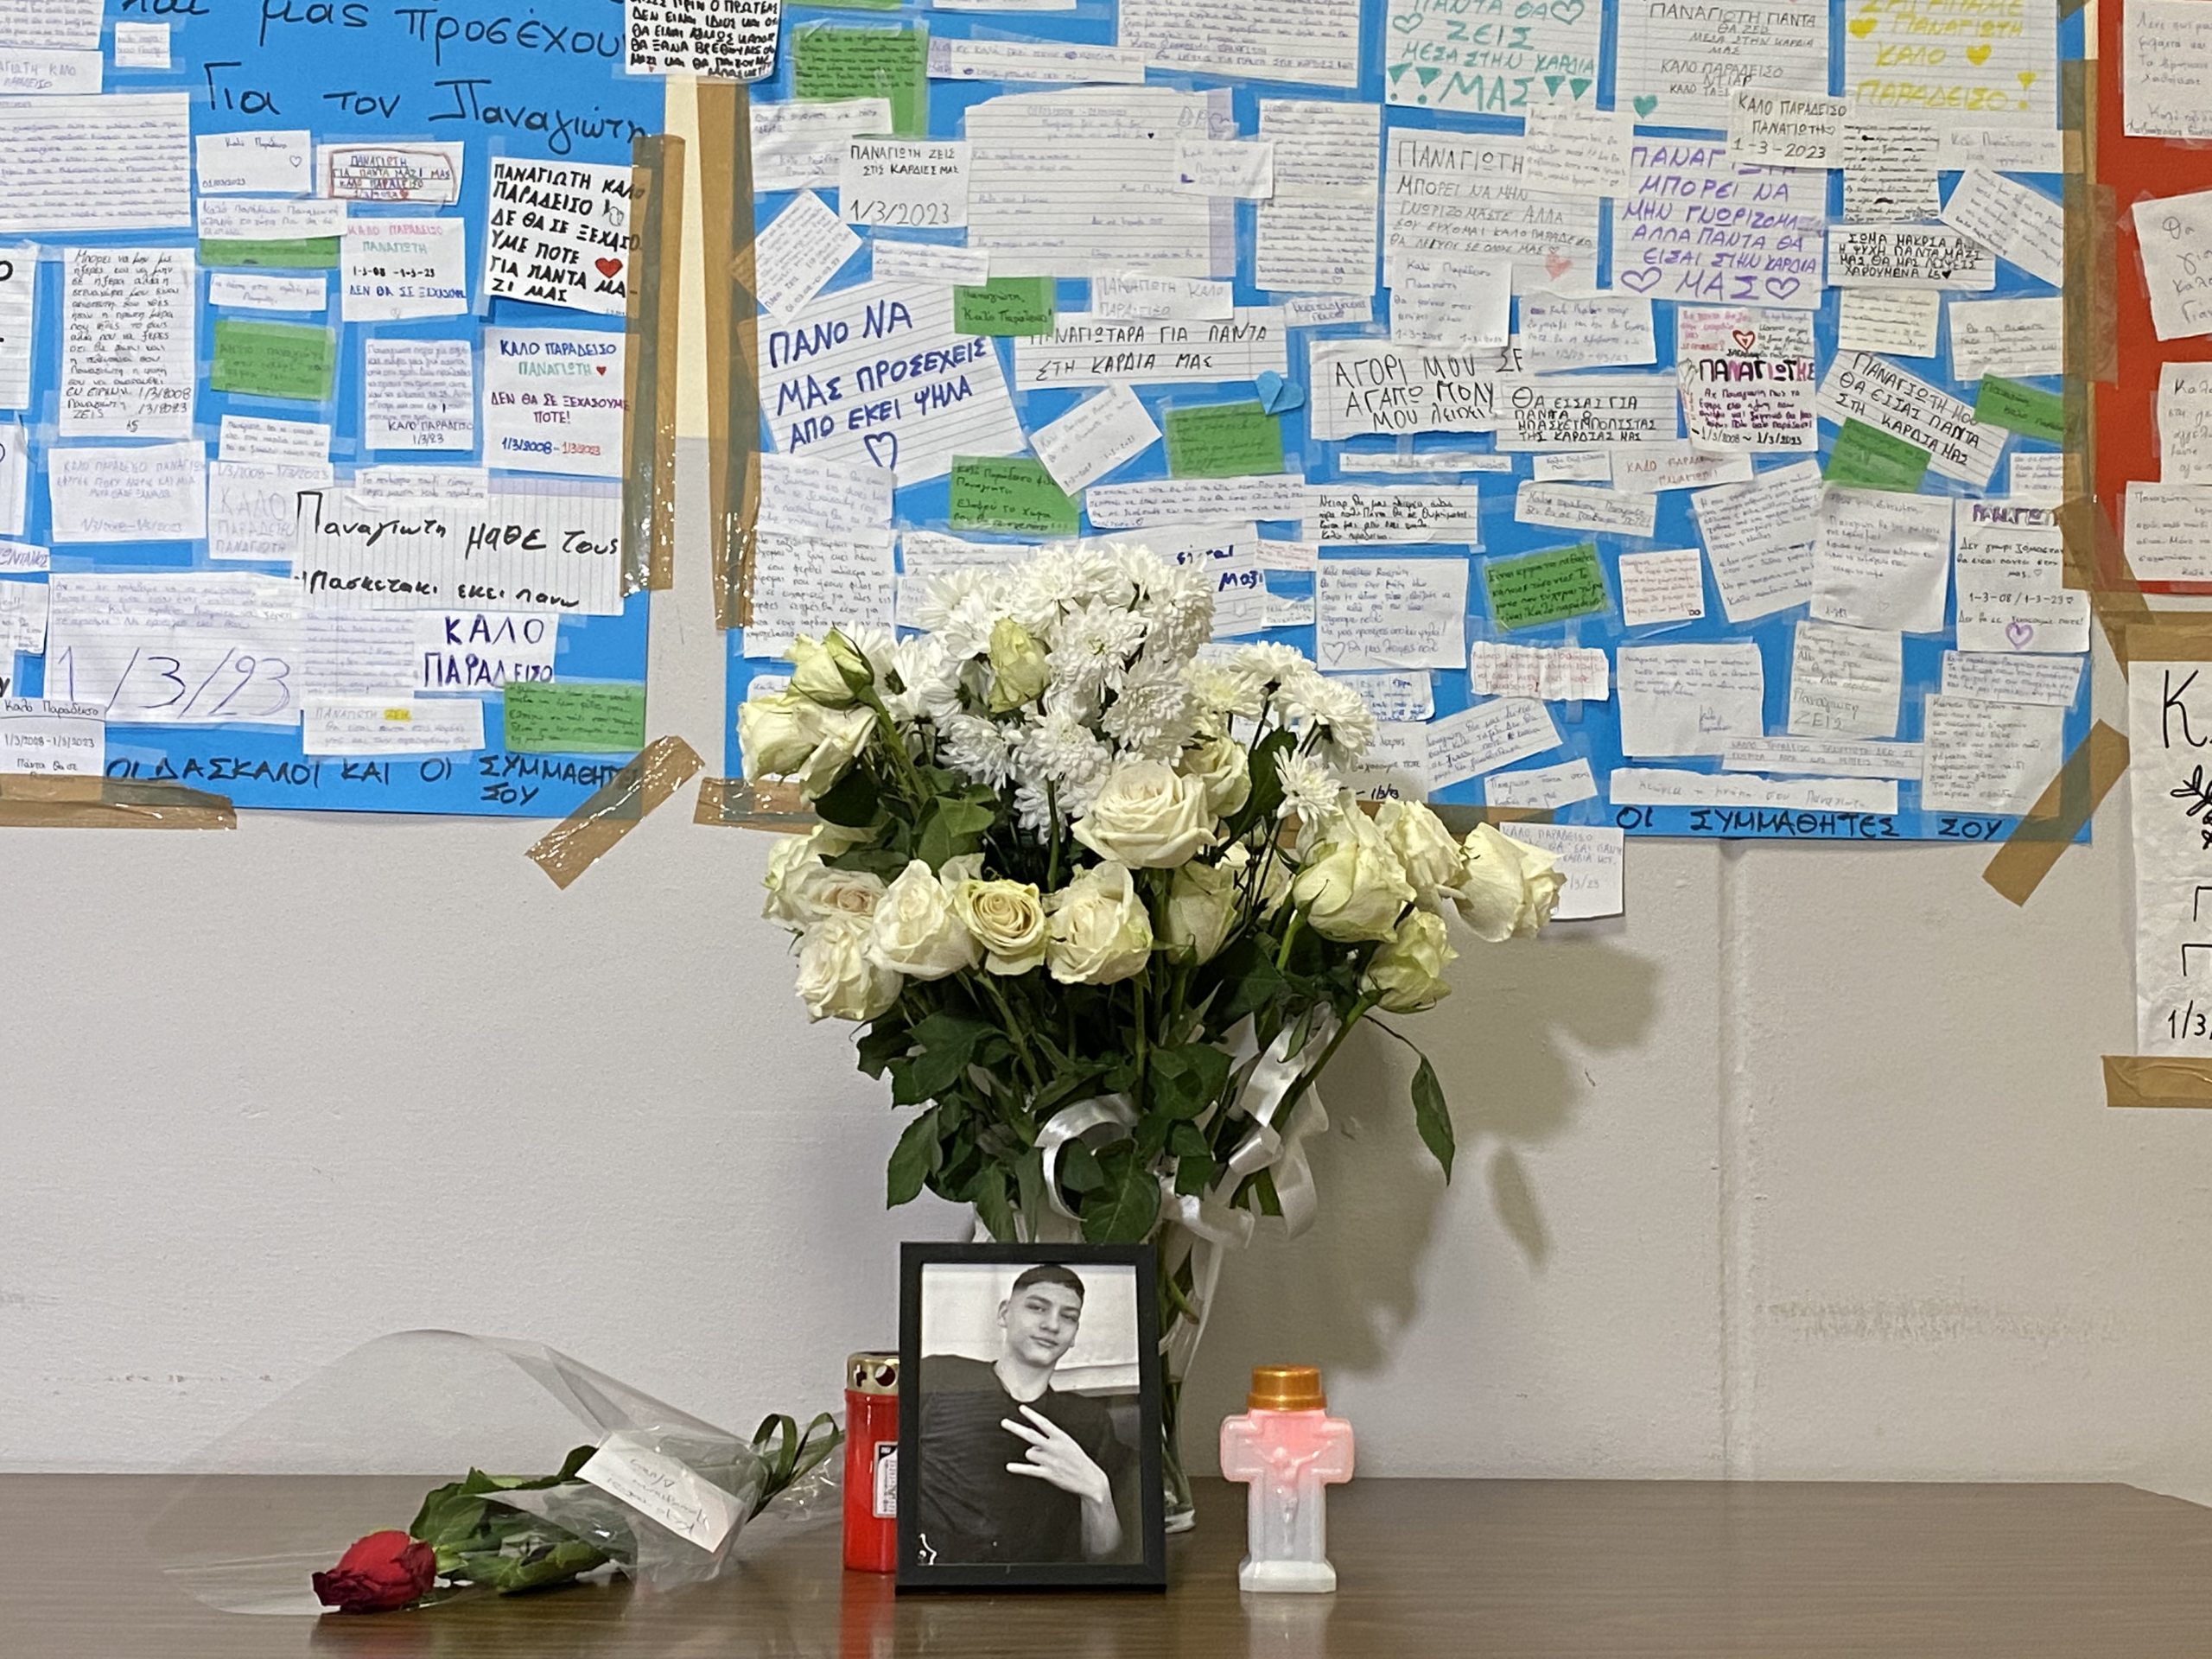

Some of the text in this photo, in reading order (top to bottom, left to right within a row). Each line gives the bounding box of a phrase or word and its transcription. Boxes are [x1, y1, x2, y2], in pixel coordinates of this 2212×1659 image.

[632, 6, 658, 22] ΔΕΝ
[1515, 2, 1548, 19] ΘΑ
[1767, 11, 1816, 28] ΠΑΝΤΑ
[260, 0, 370, 47] μας
[395, 7, 627, 66] προσέχου
[632, 24, 650, 38] ΘΑ
[1446, 20, 1535, 50] ΖΕΙΣ
[1717, 23, 1737, 35] ΘΑ
[631, 37, 690, 53] ΘΑ ΞΑΝΑ
[1402, 41, 1459, 61] ΜΕΣΑ
[1463, 50, 1523, 70] ΣΤΗΝ
[1876, 41, 1947, 67] ΚΑΛΟ
[1660, 59, 1784, 79] ΚΑΛΟ ΠΑΡΑΔΕΙΣΟ
[1438, 70, 1535, 112] ΜΑΣ
[1669, 83, 1697, 95] ΚΑΛΟ
[203, 61, 650, 155] Για τον Παναγιώτη
[1738, 93, 1848, 118] ΚΑΛΟ ΠΑΡΑΔΕΙΣΟ
[1752, 120, 1824, 136] ΠΑΝΑΓΙΩΤΗ
[850, 144, 956, 161] ΠΑΝΑΓΙΩΤΗ ΖΕΙΣ
[1397, 140, 1524, 175] ΠΑΝΑΓΙΩΤΗ
[493, 162, 593, 190] ΠΑΝΑΓΙΩΤΗ
[862, 163, 960, 177] ΣΤΙΣ ΚΑΡΔΙΕΣ ΜΑΣ
[493, 181, 594, 216] ΠΑΡΑΔΕΙΣΟ
[1395, 175, 1529, 201] ΜΠΟΡΕΙ ΝΑ ΜΗΝ
[1637, 175, 1789, 202] ΜΠΟΡΕΙ ΝΑ
[490, 207, 518, 228] ΔΕ
[521, 213, 546, 230] ΘΑ
[550, 217, 568, 235] ΣΕ
[849, 198, 950, 227] 1/3/2023
[1522, 204, 1563, 224] ΑΛΛΑ
[1621, 199, 1673, 222] ΜΗΝ
[1389, 232, 1406, 246] ΘΑ
[1393, 218, 1526, 238] ΣΟΥ ΕΥΧΟΜΑΙ ΚΑΛΟ
[1631, 223, 1803, 252] ΑΛΛΑ ΠΑΝΤΑ ΘΑ
[1848, 232, 1888, 245] ΣΩΜΑ
[492, 230, 580, 264] ΥΜΕ ΠΟΤΕ
[1643, 247, 1701, 265] ΕΙΣΑΙ
[1711, 251, 1761, 269] ΣΤΗΝ
[1839, 244, 1847, 253] Η
[1853, 245, 1886, 257] ΨΥΧΗ
[1894, 245, 1941, 259] ΠΑΝΤΑ
[490, 256, 520, 277] ΓΙΑ
[529, 264, 588, 289] ΠΑΝΤΑ
[1840, 255, 1920, 269] ΜΑΣ ΘΑ ΜΑΣ
[1845, 265, 1919, 280] ΧΑΡΟΥΜΕΝΑ
[349, 284, 370, 296] ΔΕΝ
[376, 284, 394, 297] ΘΑ
[492, 277, 568, 303] ΖΙ ΜΑΣ
[1675, 269, 1760, 302] ΜΑΣ
[768, 299, 913, 369] ΠΑΝΟ ΝΑ
[1160, 322, 1268, 343] ΓΙΑ ΠΑΝΤΑ
[499, 339, 617, 357] ΚΑΛΟ ΠΑΡΑΔΕΙΣΟ
[518, 361, 592, 378] ΠΑΝΑΓΙΩΤΗ
[777, 335, 987, 416] ΜΑΣ ΠΡΟΣΕΧΕΙΣ
[1036, 353, 1213, 381] ΣΤΗ ΚΑΡΔΙΑ ΜΑΣ
[1335, 353, 1408, 389] ΑΓΟΡΙ
[1423, 353, 1476, 380] ΜΟΥ
[1852, 351, 1946, 414] ΠΑΝΑΓΙΩΤΗ
[491, 391, 515, 407] ΔΕΝ
[521, 394, 537, 406] ΘΑ
[543, 395, 557, 408] ΣΕ
[1344, 380, 1494, 418] ΑΓΑΠΩ ΠΟΛΥ
[1511, 386, 1638, 410] ΘΑ ΕΙΣΑΙ ΓΙΑ
[1839, 371, 1980, 448] ΘΑ ΕΙΣΑΙ ΠΑΝΤΑ
[388, 420, 416, 431] ΚΑΛΟ
[533, 410, 571, 425] ΠΟΤΕ!
[789, 374, 973, 454] ΑΠΟ ΕΚΕΙ ΨΗΛΑ
[1372, 409, 1418, 432] ΜΟΥ
[1514, 410, 1569, 420] ΠΑΝΤΑ
[412, 433, 445, 446] 1/3/23
[1519, 431, 1643, 442] ΤΗΣ ΚΑΡΔΙΑΣ ΜΑΣ
[1835, 391, 1969, 467] ΣΤΗ ΚΑΡΔΙΑ ΜΑΣ
[562, 530, 618, 556] τους
[516, 590, 580, 607] πανω
[444, 613, 544, 645] ΚΑΛΟ
[423, 652, 553, 687] ΠΑΡΑΔΕΙΣΟ
[105, 757, 139, 780] ΟΙ
[155, 757, 321, 788] ΔΑΣΚΑΛΟΙ
[340, 761, 390, 786] ΚΑΙ
[420, 757, 452, 783] ΟΙ
[480, 781, 540, 806] ΣΟΥ
[1616, 809, 2003, 840] ΟΙ ΣΥΜΜΑΘΗΤΕΣ ΣΟΥ
